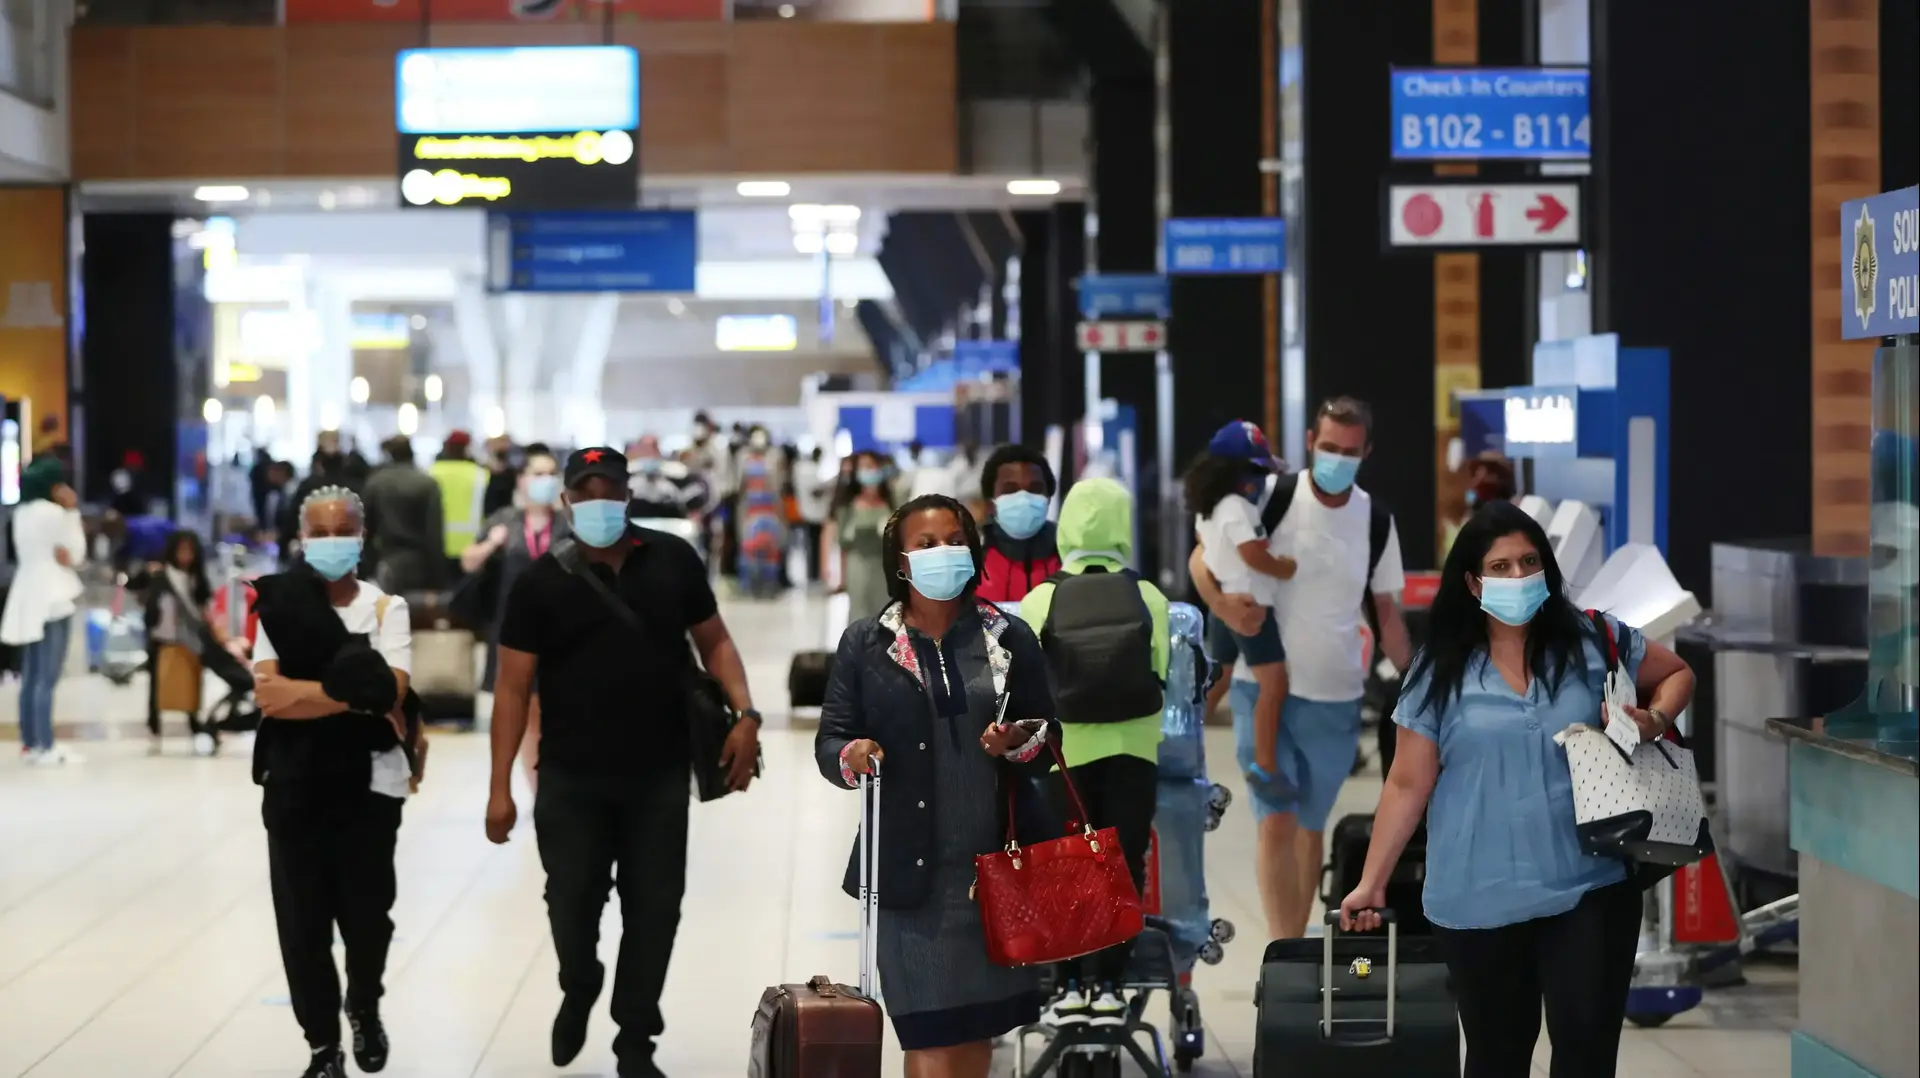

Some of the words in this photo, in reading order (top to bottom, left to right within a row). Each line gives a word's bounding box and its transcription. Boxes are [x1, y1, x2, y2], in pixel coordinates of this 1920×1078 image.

[1495, 75, 1587, 98] Counters
[1402, 114, 1483, 148] B102
[1889, 274, 1919, 320] POLI
